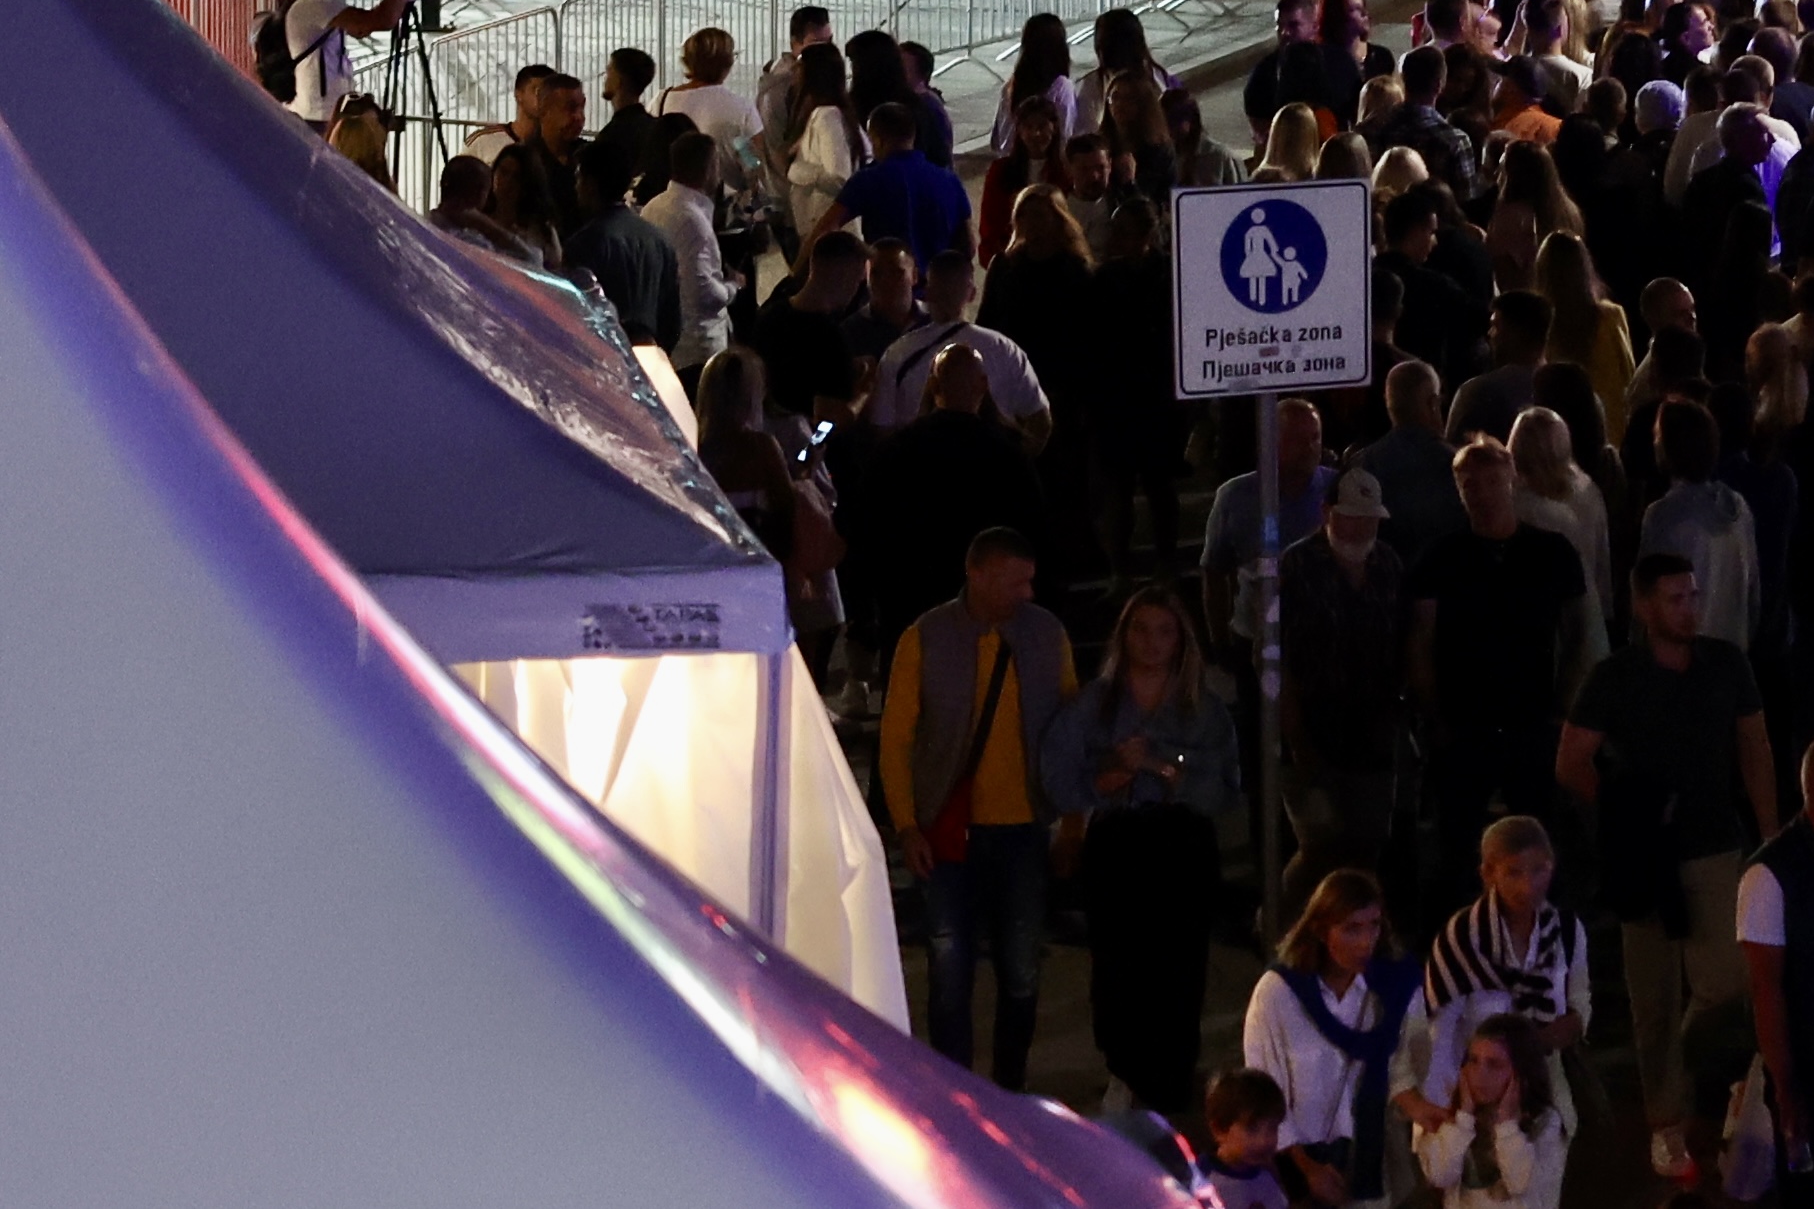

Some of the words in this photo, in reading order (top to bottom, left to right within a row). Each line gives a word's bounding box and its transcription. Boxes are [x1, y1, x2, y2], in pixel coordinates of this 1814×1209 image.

[1205, 326, 1292, 351] Pješačka
[1298, 325, 1343, 342] zona
[1203, 359, 1296, 382] Пјешачка
[1303, 355, 1345, 372] зона
